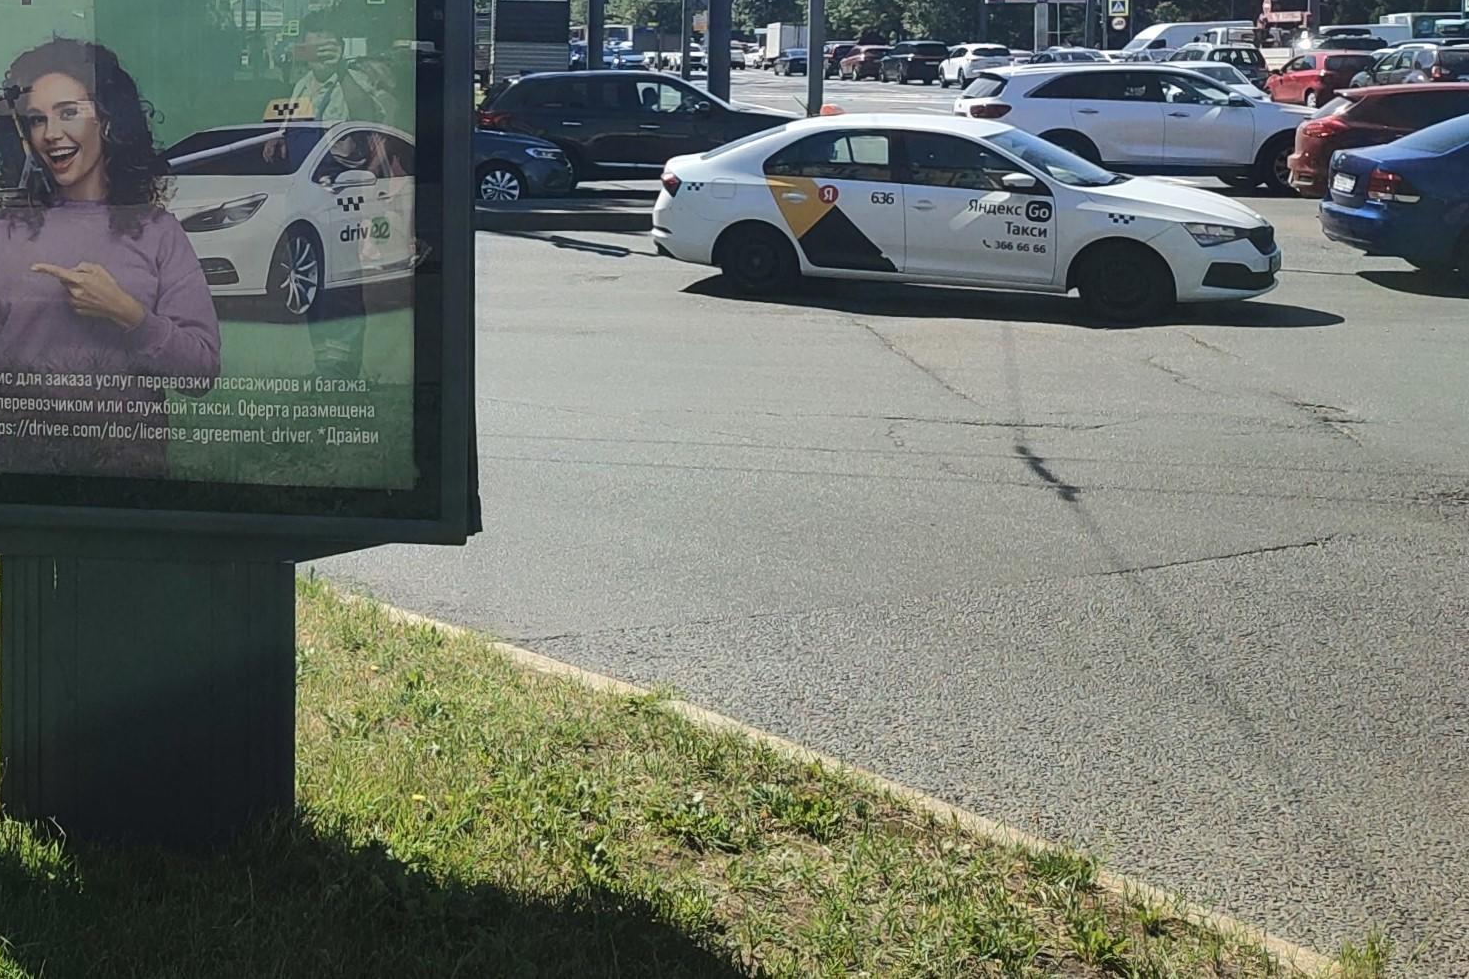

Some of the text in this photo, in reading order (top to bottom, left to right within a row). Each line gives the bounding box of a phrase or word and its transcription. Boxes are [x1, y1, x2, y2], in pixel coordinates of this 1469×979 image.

[870, 191, 895, 205] 636
[968, 199, 1050, 219] Яндекс Go
[340, 218, 390, 243] drivee
[1004, 221, 1047, 238] Такси
[994, 240, 1046, 253] 366 66 66
[16, 372, 42, 387] для
[45, 373, 92, 387] заказа
[96, 374, 134, 391] услуг
[137, 375, 210, 391] перевозки
[214, 377, 300, 394] пассажиров
[303, 379, 312, 392] и
[315, 376, 370, 392] багажа.
[97, 400, 123, 413] или
[126, 398, 187, 417] службой
[191, 402, 234, 416] такси.
[238, 399, 289, 421] Оферта
[293, 404, 375, 421] размещена
